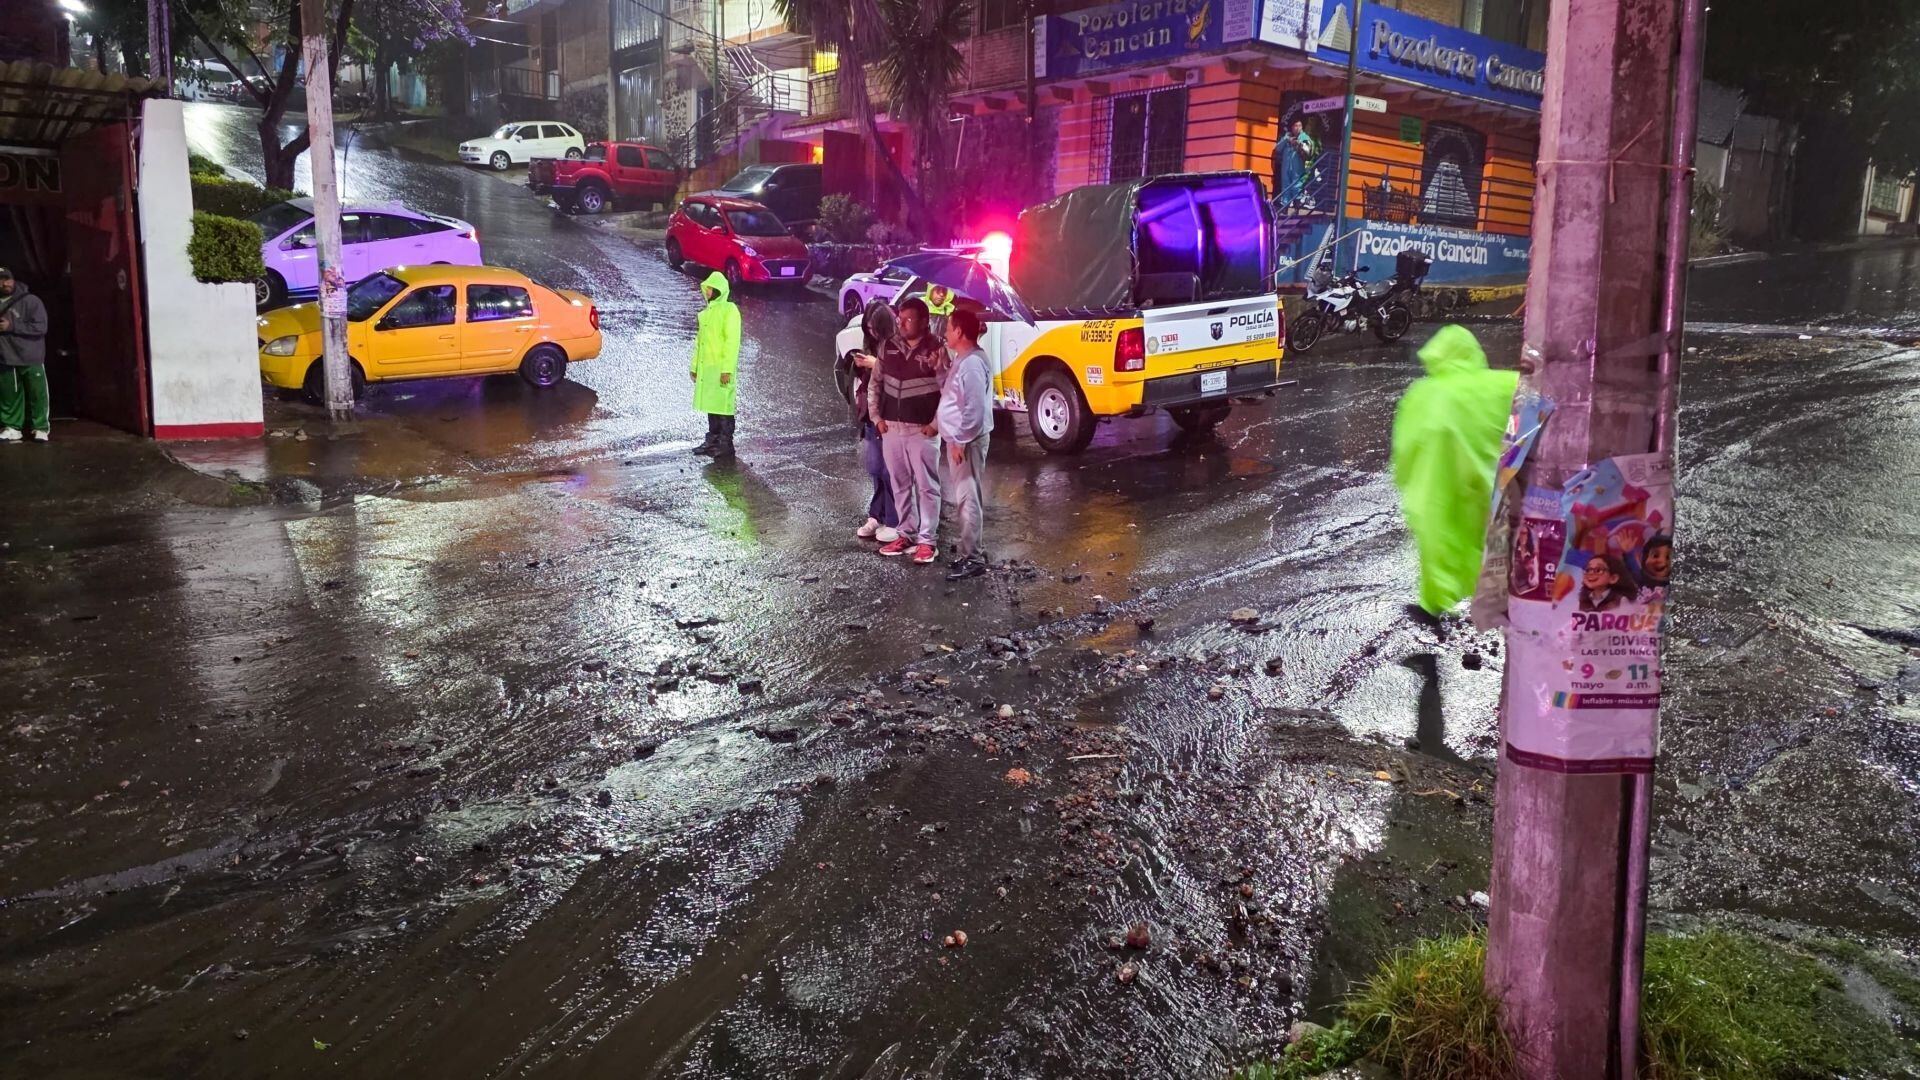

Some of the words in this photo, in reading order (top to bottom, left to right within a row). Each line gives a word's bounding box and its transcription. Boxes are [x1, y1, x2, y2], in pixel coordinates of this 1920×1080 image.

[1085, 28, 1171, 59] Cancún
[1486, 54, 1545, 93] Cancú
[1437, 239, 1487, 265] Cancún
[1230, 309, 1273, 327] POLICÍA
[1581, 648, 1599, 656] LAS
[1602, 648, 1607, 656] Y
[1609, 648, 1627, 656] LOS
[1581, 663, 1594, 679] 9
[1627, 664, 1648, 680] 11
[1571, 682, 1604, 690] mayo
